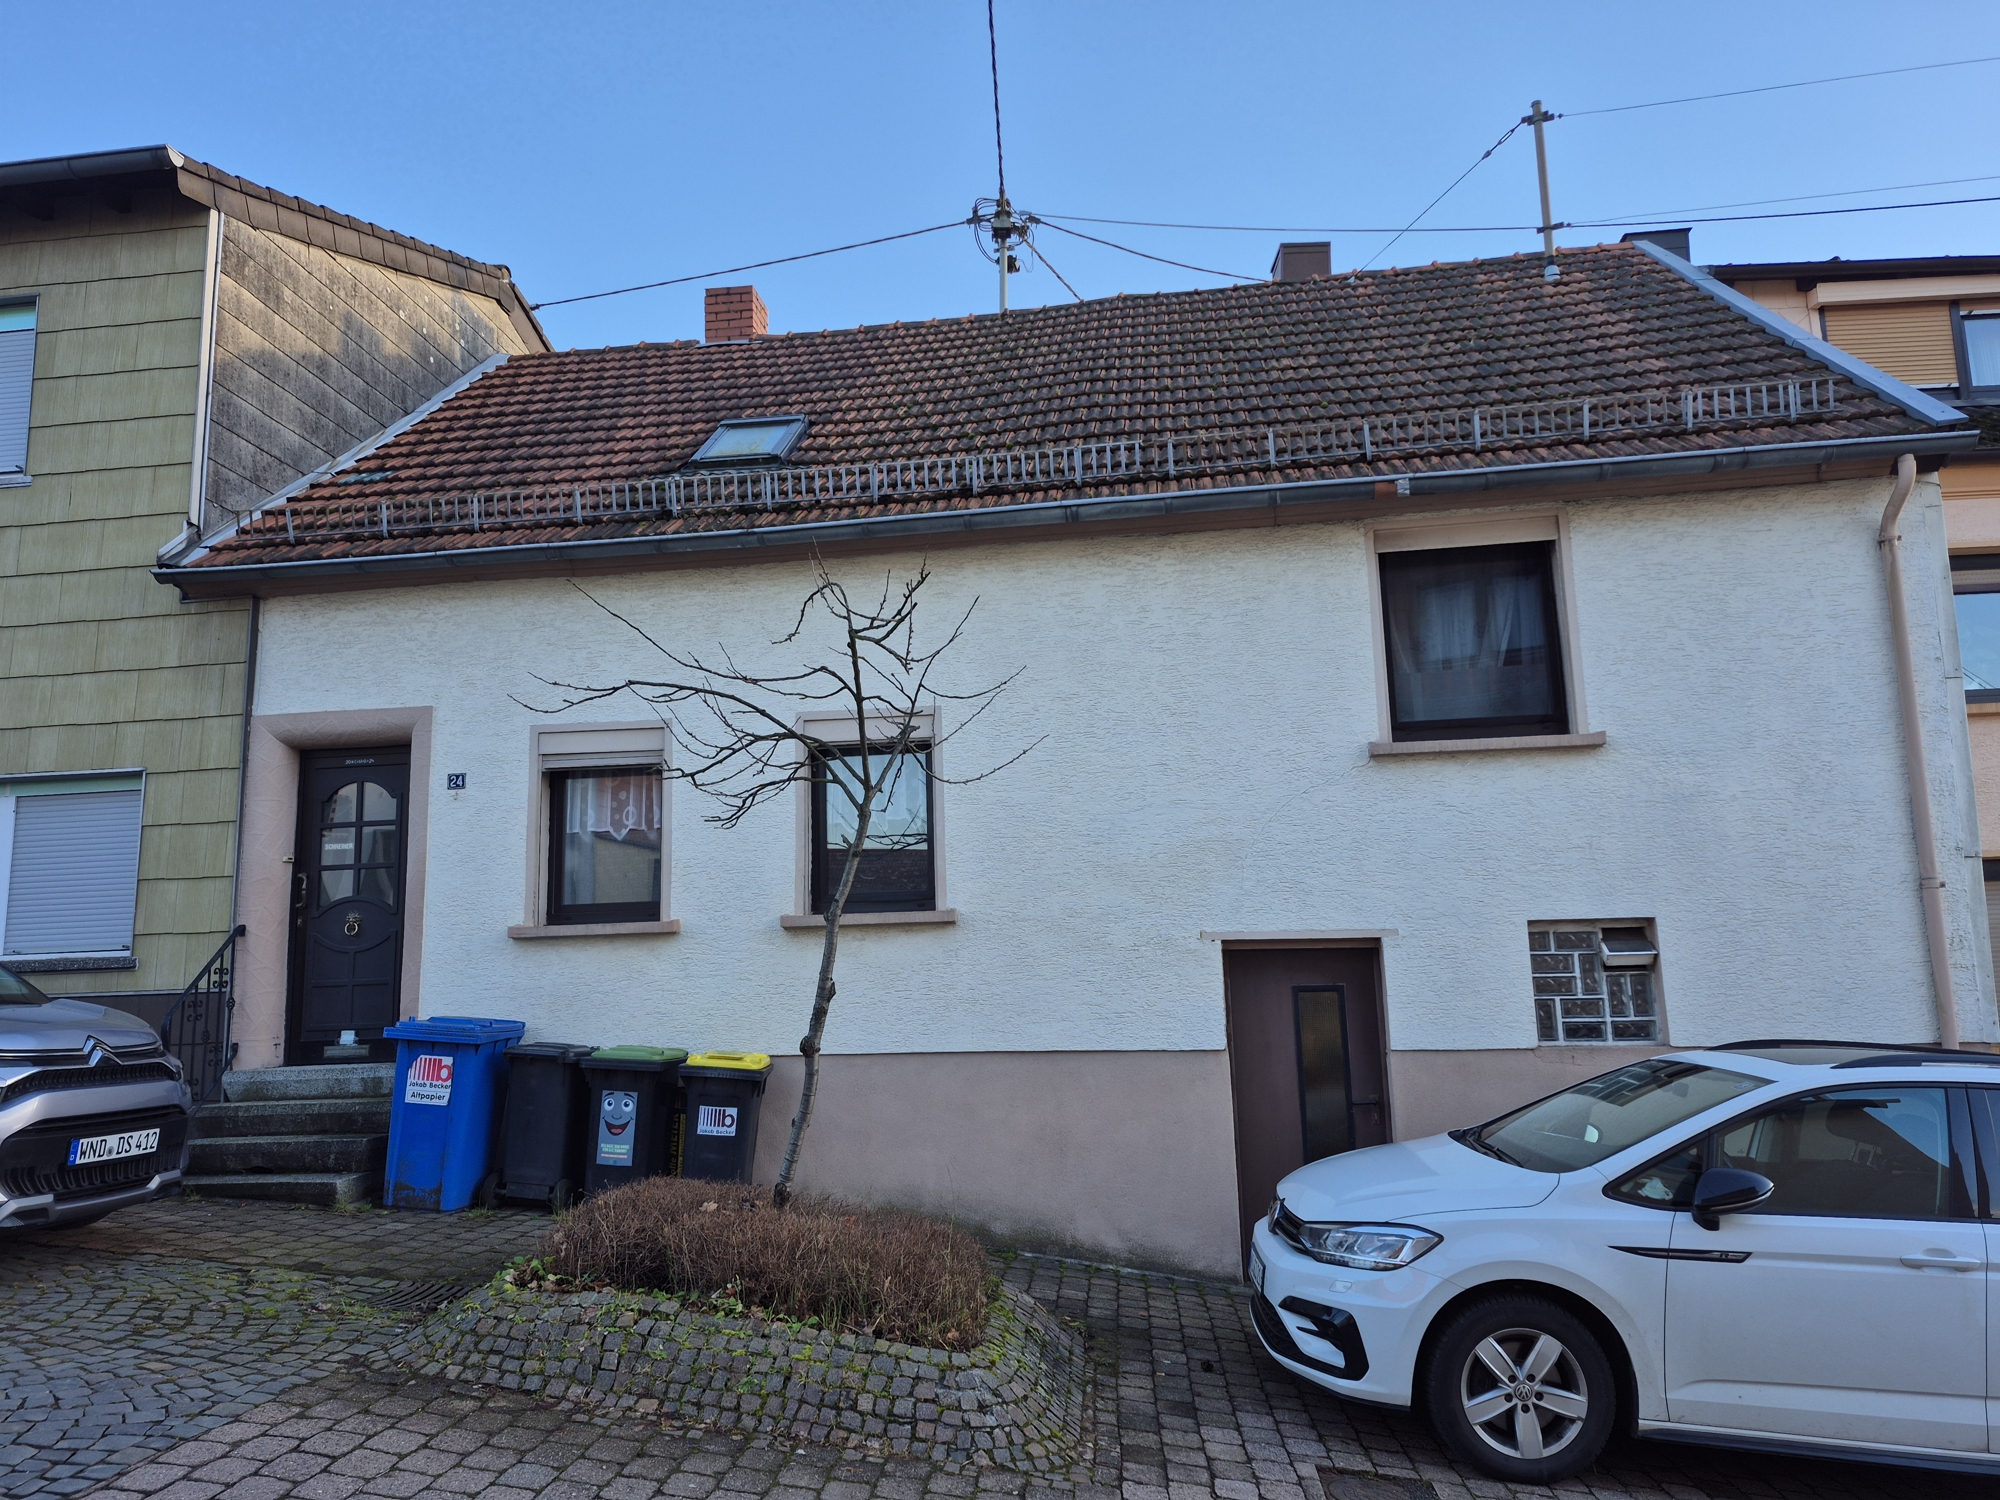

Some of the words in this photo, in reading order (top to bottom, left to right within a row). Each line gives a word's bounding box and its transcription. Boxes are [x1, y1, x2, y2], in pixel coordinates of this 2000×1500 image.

[450, 775, 463, 787] 24
[411, 1091, 445, 1101] Altpapier
[79, 1139, 107, 1161] WND
[116, 1135, 133, 1155] DS
[135, 1132, 158, 1151] 412
